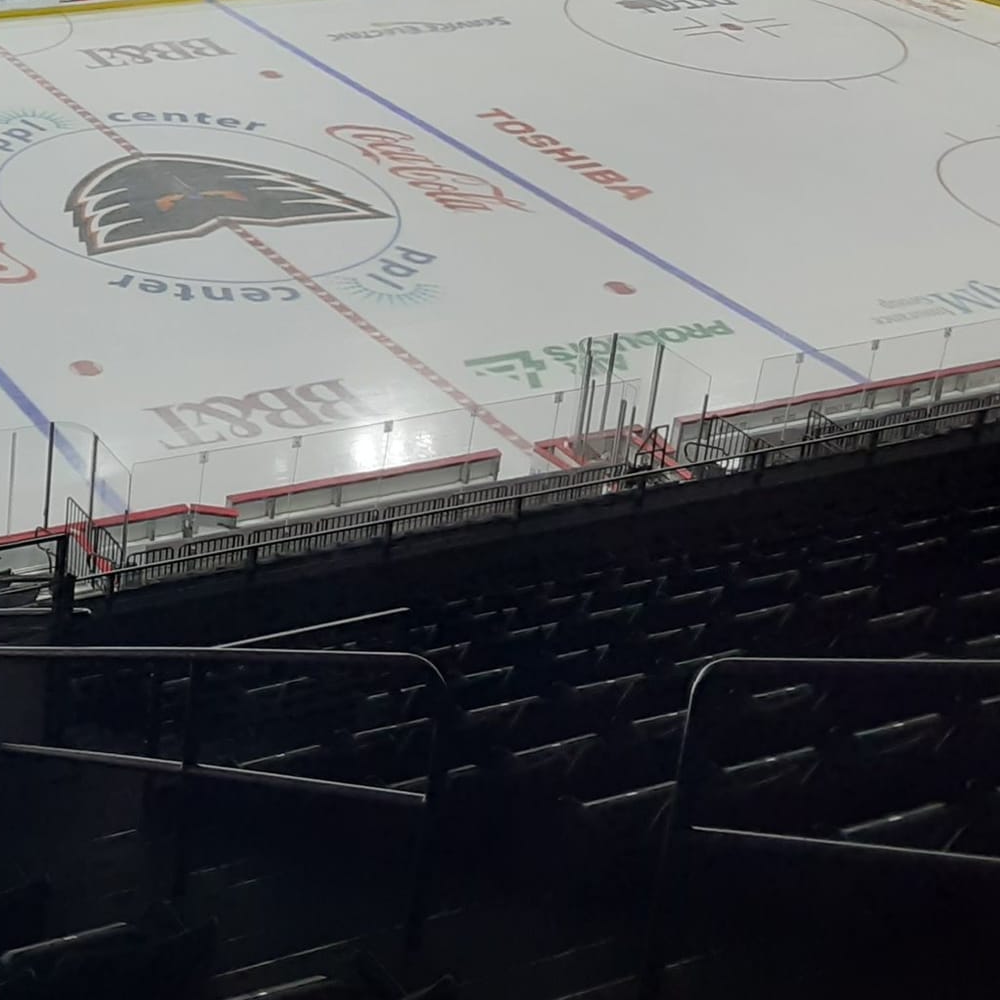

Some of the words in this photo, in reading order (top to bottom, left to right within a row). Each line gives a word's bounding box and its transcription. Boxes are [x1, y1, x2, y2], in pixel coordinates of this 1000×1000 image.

[106, 110, 267, 132] center
[476, 107, 653, 200] TOSHIBA
[108, 274, 300, 302] center
[366, 245, 438, 290] ppl
[143, 378, 365, 450] BB&T
